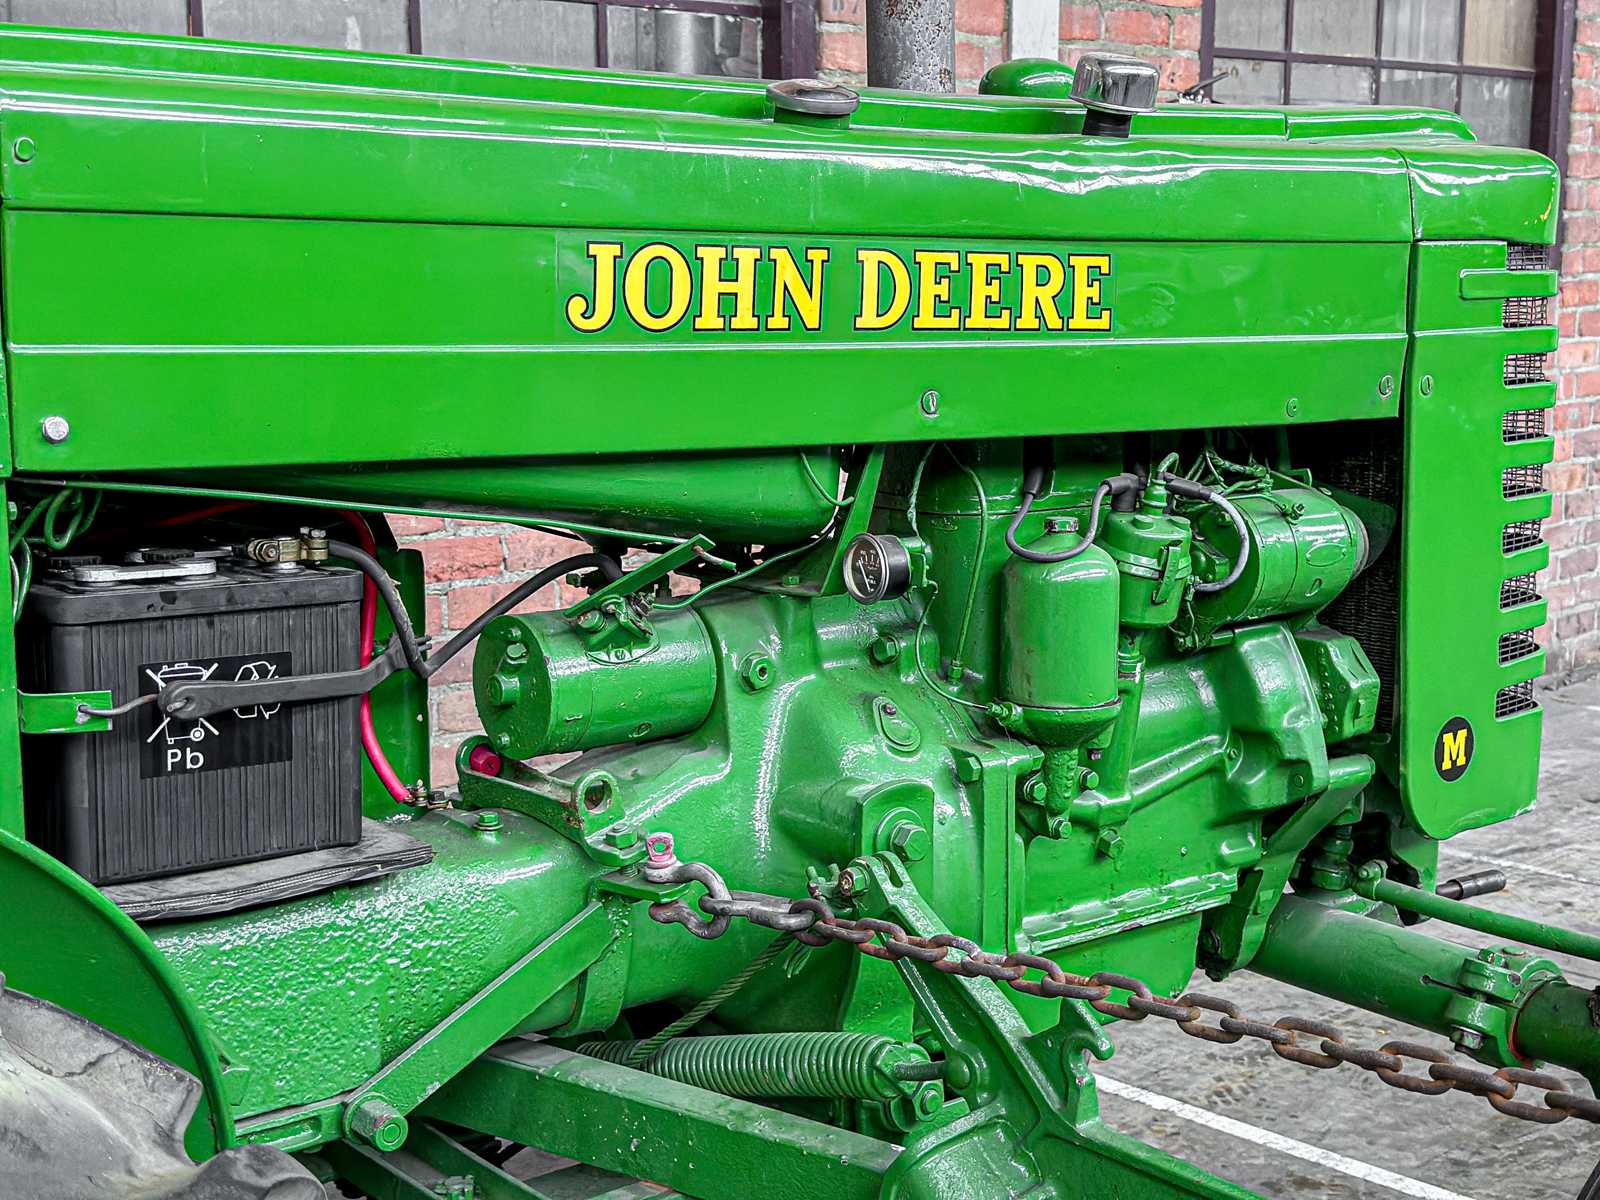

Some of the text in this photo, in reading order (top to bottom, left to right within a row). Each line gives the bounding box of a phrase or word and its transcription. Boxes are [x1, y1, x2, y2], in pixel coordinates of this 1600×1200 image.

[566, 241, 1111, 333] JOHN DEERE
[167, 747, 204, 771] Pb
[1442, 729, 1467, 770] M
